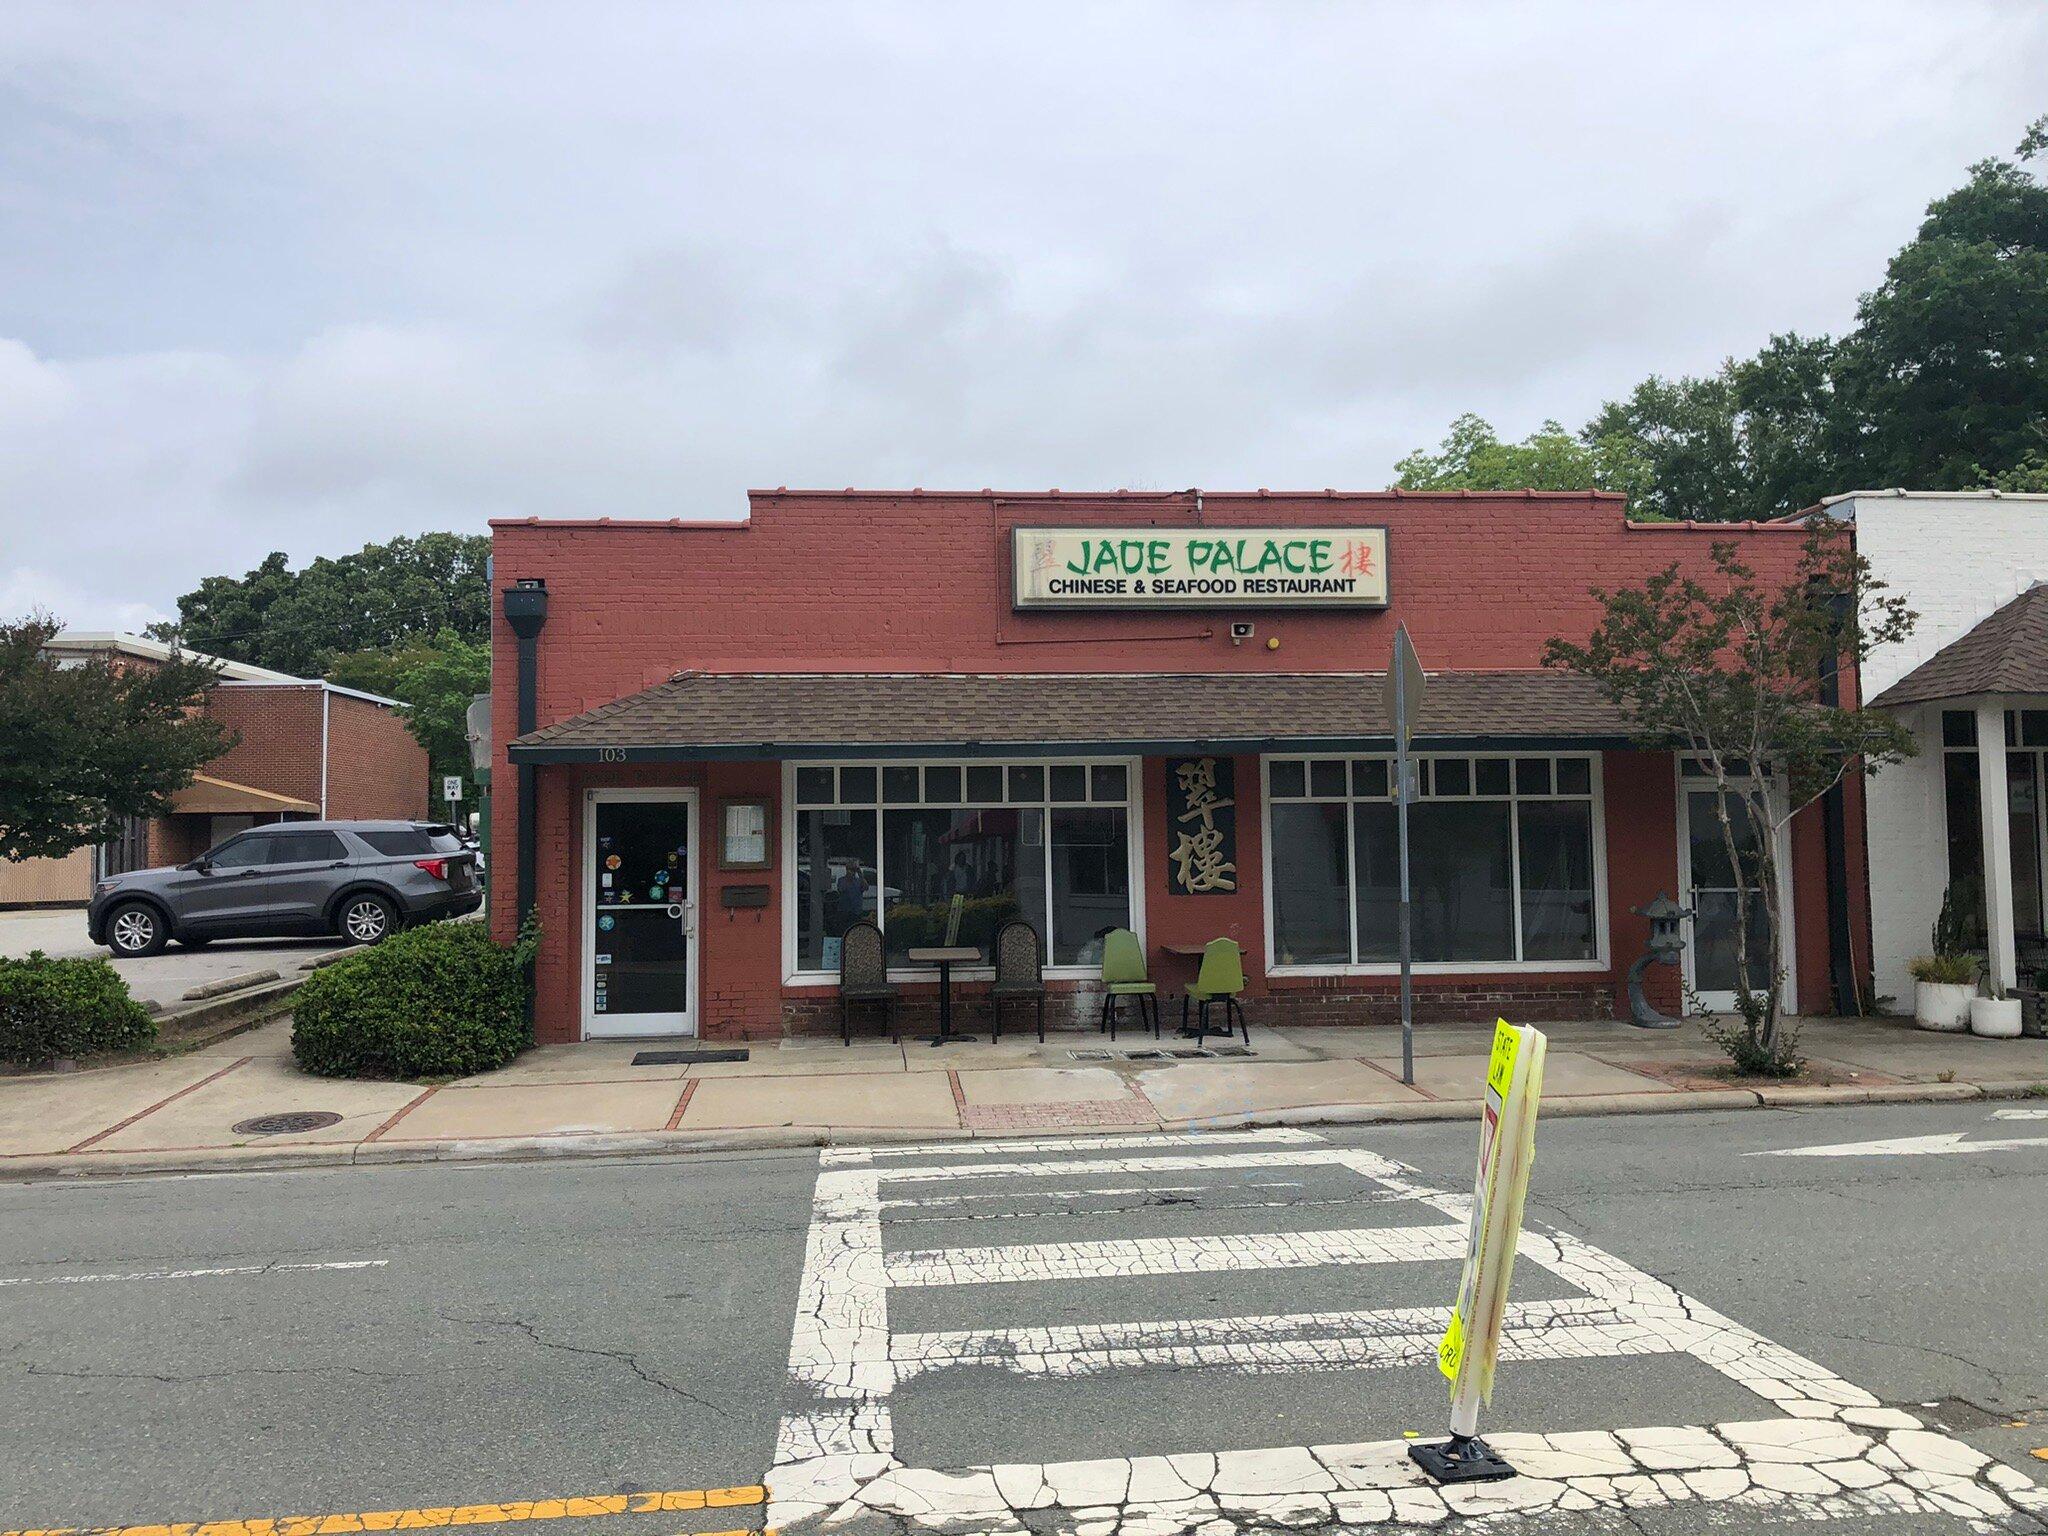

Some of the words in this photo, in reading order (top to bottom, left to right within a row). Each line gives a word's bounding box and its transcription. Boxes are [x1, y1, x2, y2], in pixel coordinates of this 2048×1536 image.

[1066, 540, 1173, 576] JADE
[1186, 538, 1334, 576] PALACE
[1049, 579, 1127, 594] CHINESE
[1133, 580, 1146, 593] &
[1152, 579, 1236, 594] SEAFOOD
[1244, 578, 1357, 593] RESTAURANT
[598, 747, 627, 763] 103
[1496, 1030, 1514, 1060] STATE
